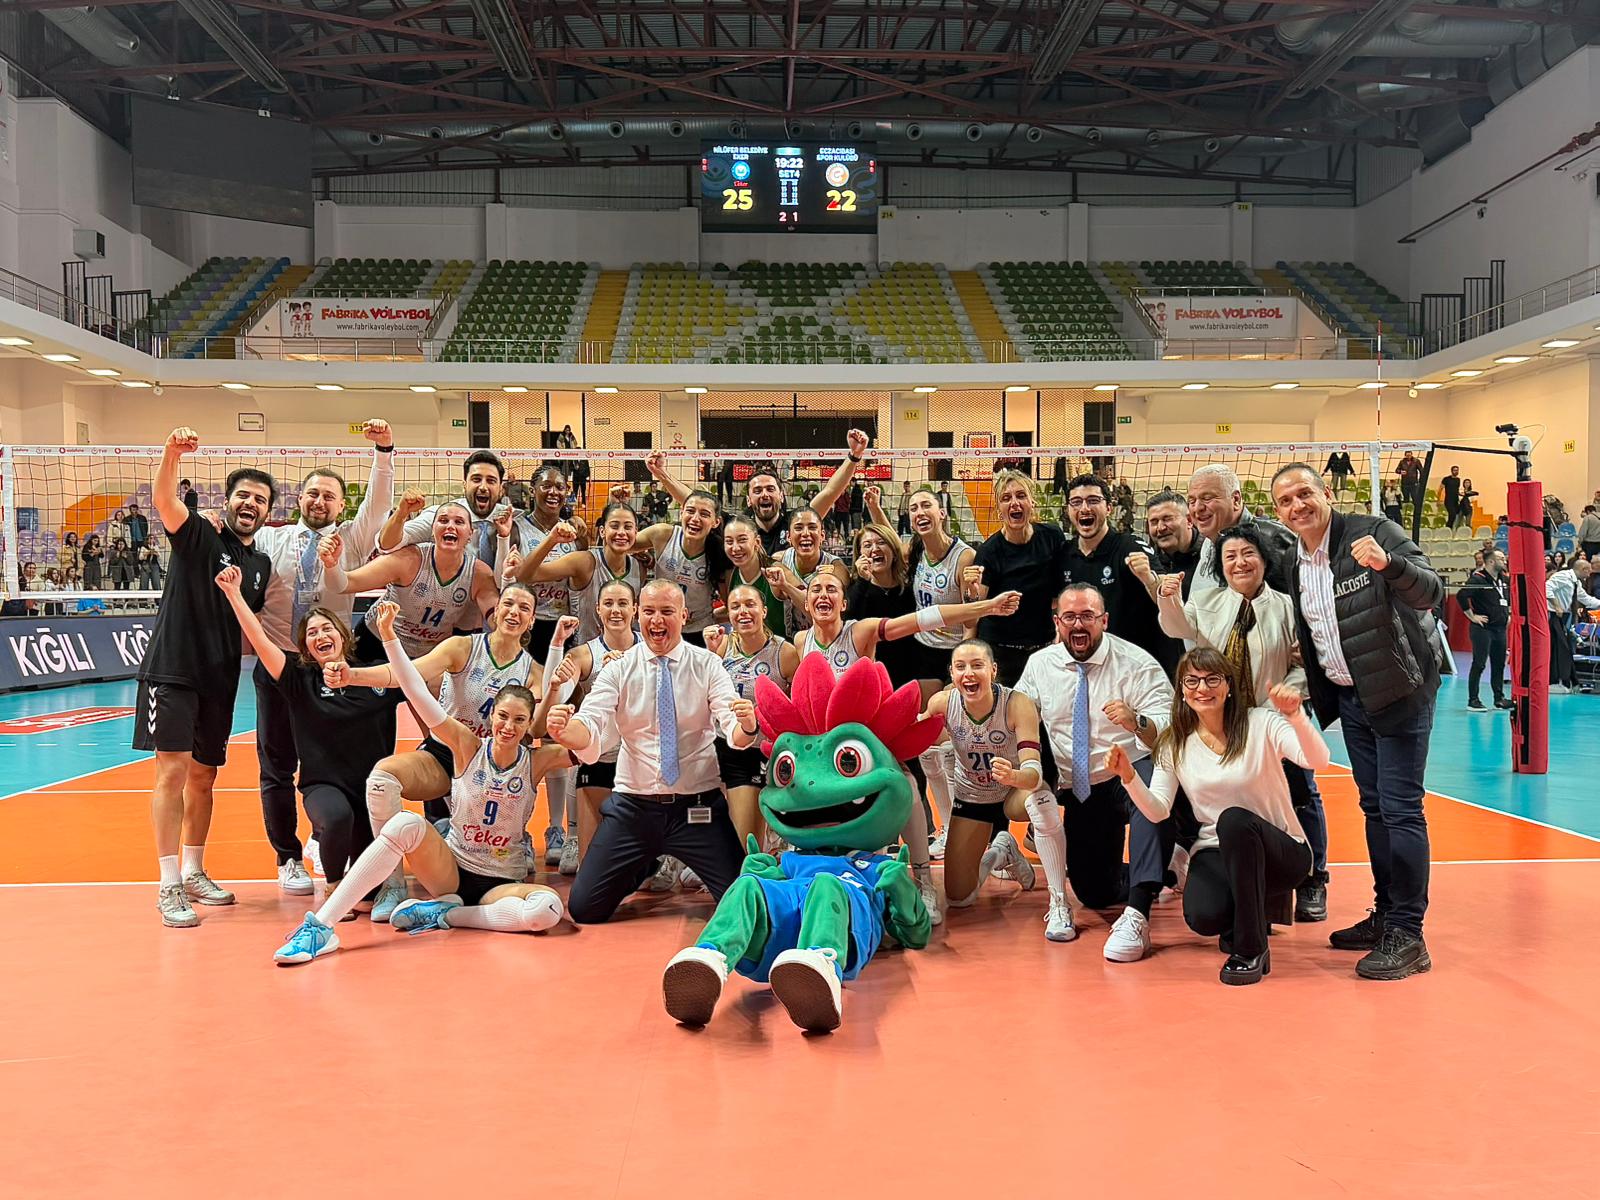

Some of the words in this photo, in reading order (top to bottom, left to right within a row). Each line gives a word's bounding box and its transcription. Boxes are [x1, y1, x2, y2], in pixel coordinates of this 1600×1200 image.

[775, 157, 804, 168] 19:22
[722, 189, 753, 210] 25
[826, 190, 857, 211] 22
[779, 211, 787, 221] 2
[792, 211, 798, 221] 1
[1222, 308, 1284, 319] VOLEYBOL
[336, 323, 419, 331] www.fabrikavoleybol.com
[1189, 322, 1269, 331] www.fabrikavoleybol.com
[1334, 571, 1370, 598] ACOSTE
[421, 606, 446, 627] 14
[581, 774, 589, 783] 11
[483, 800, 499, 825] 9
